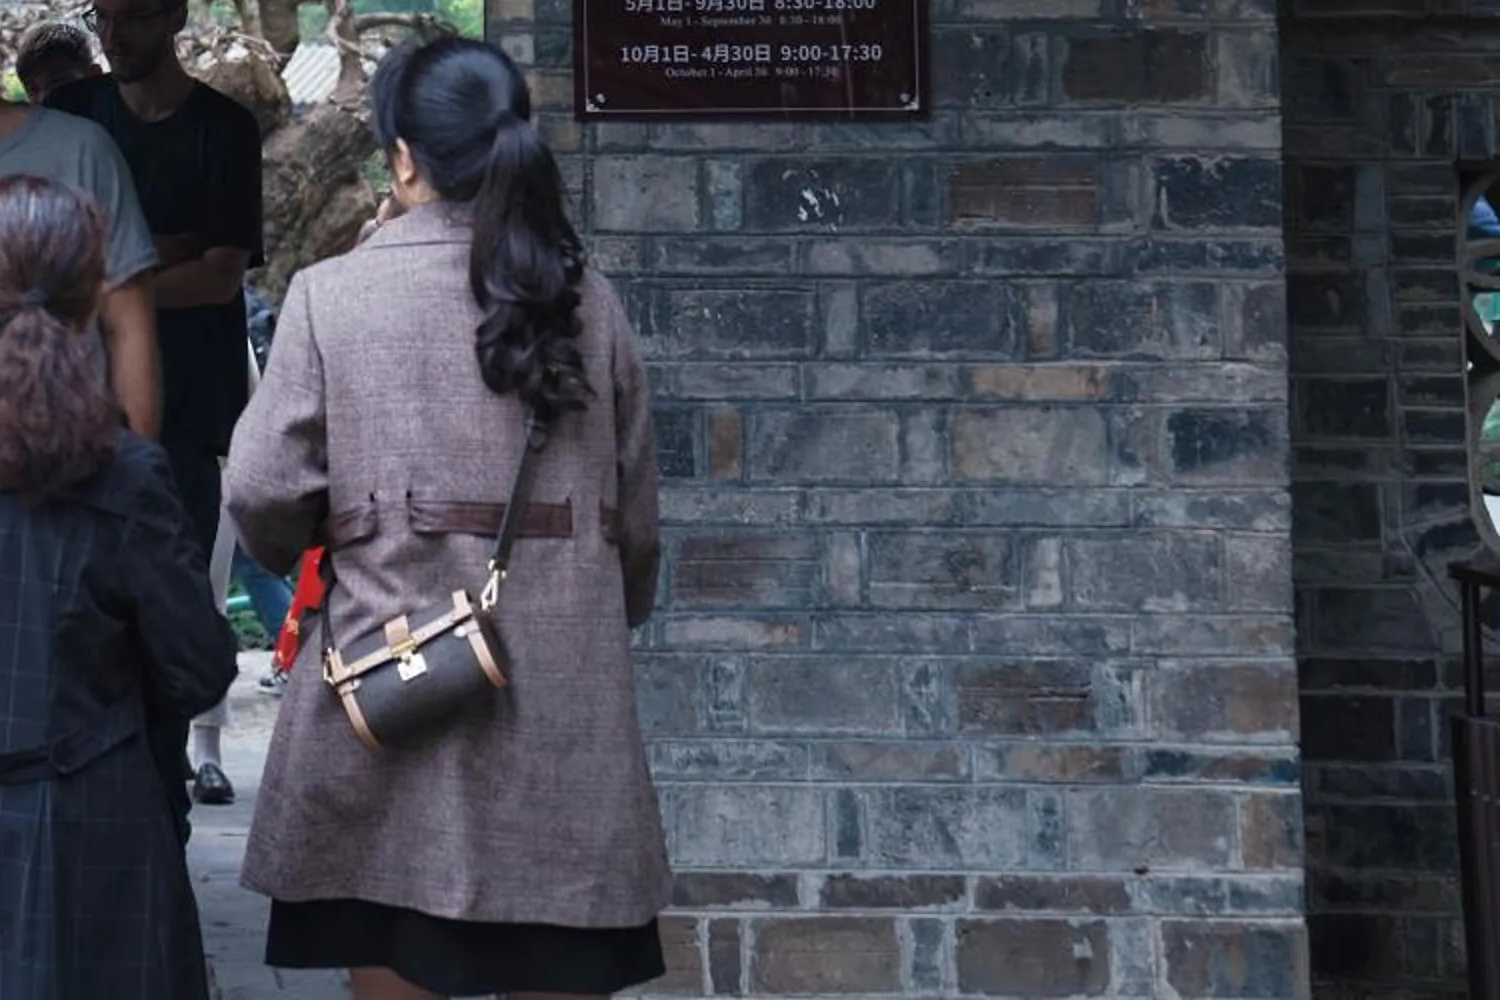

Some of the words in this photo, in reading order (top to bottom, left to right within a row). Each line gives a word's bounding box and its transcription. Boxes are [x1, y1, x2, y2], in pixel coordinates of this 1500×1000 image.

[660, 15, 682, 28] May
[700, 15, 755, 28] September
[781, 44, 882, 60] 9:00-17:30
[665, 67, 707, 79] October
[724, 67, 753, 79] April
